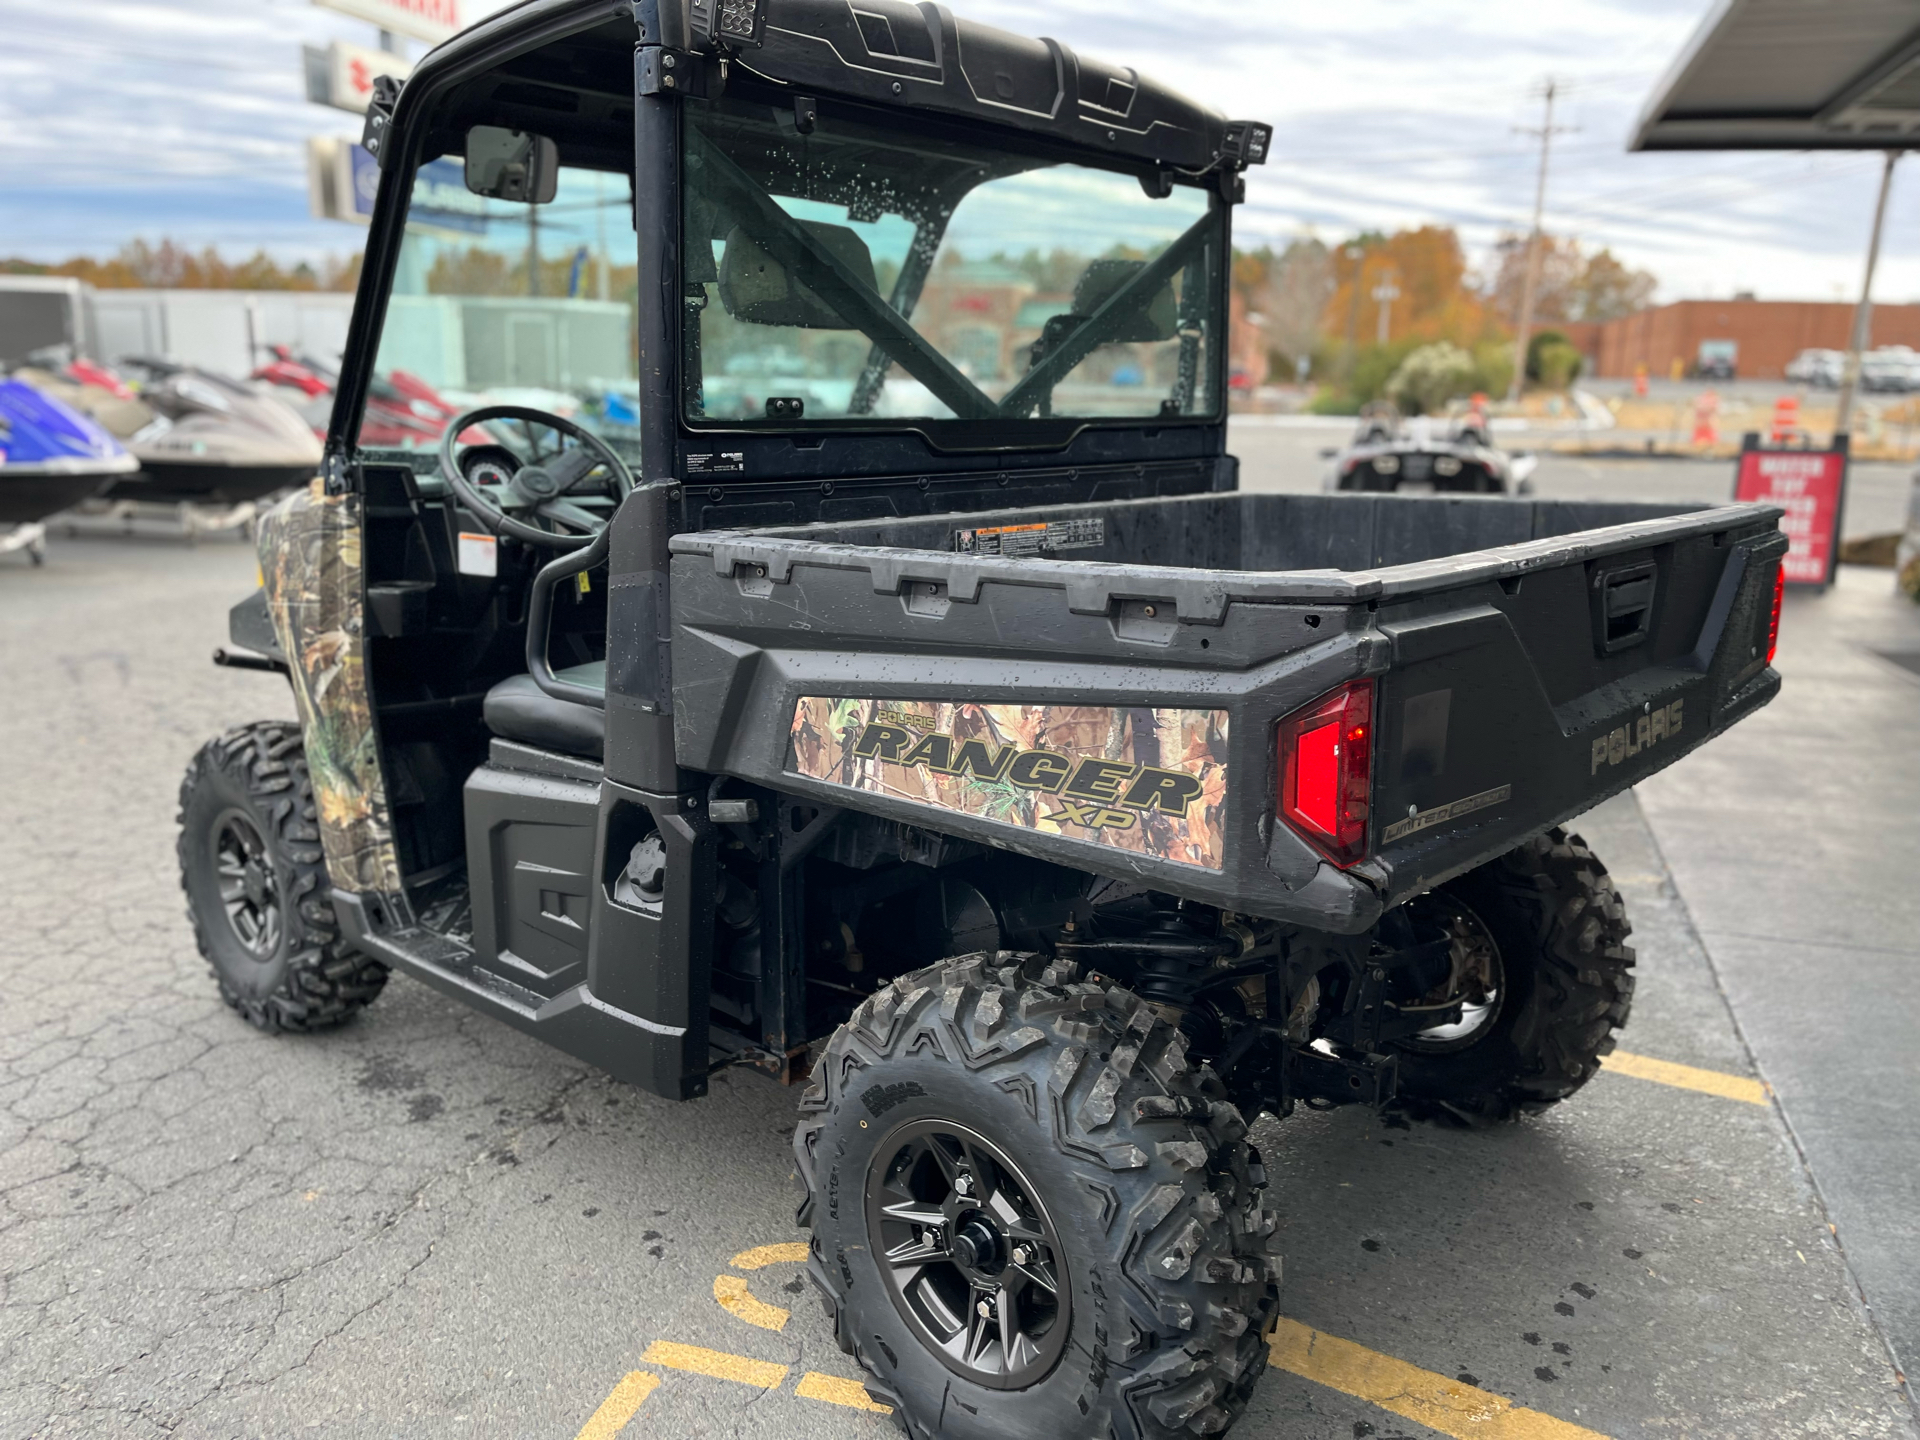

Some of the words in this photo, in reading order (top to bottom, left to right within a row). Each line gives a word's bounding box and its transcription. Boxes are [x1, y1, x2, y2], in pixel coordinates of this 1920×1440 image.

[878, 710, 936, 730] POLARIS
[1591, 698, 1684, 776] POLARIS
[853, 722, 1204, 818] RANGER
[1040, 798, 1138, 830] XP
